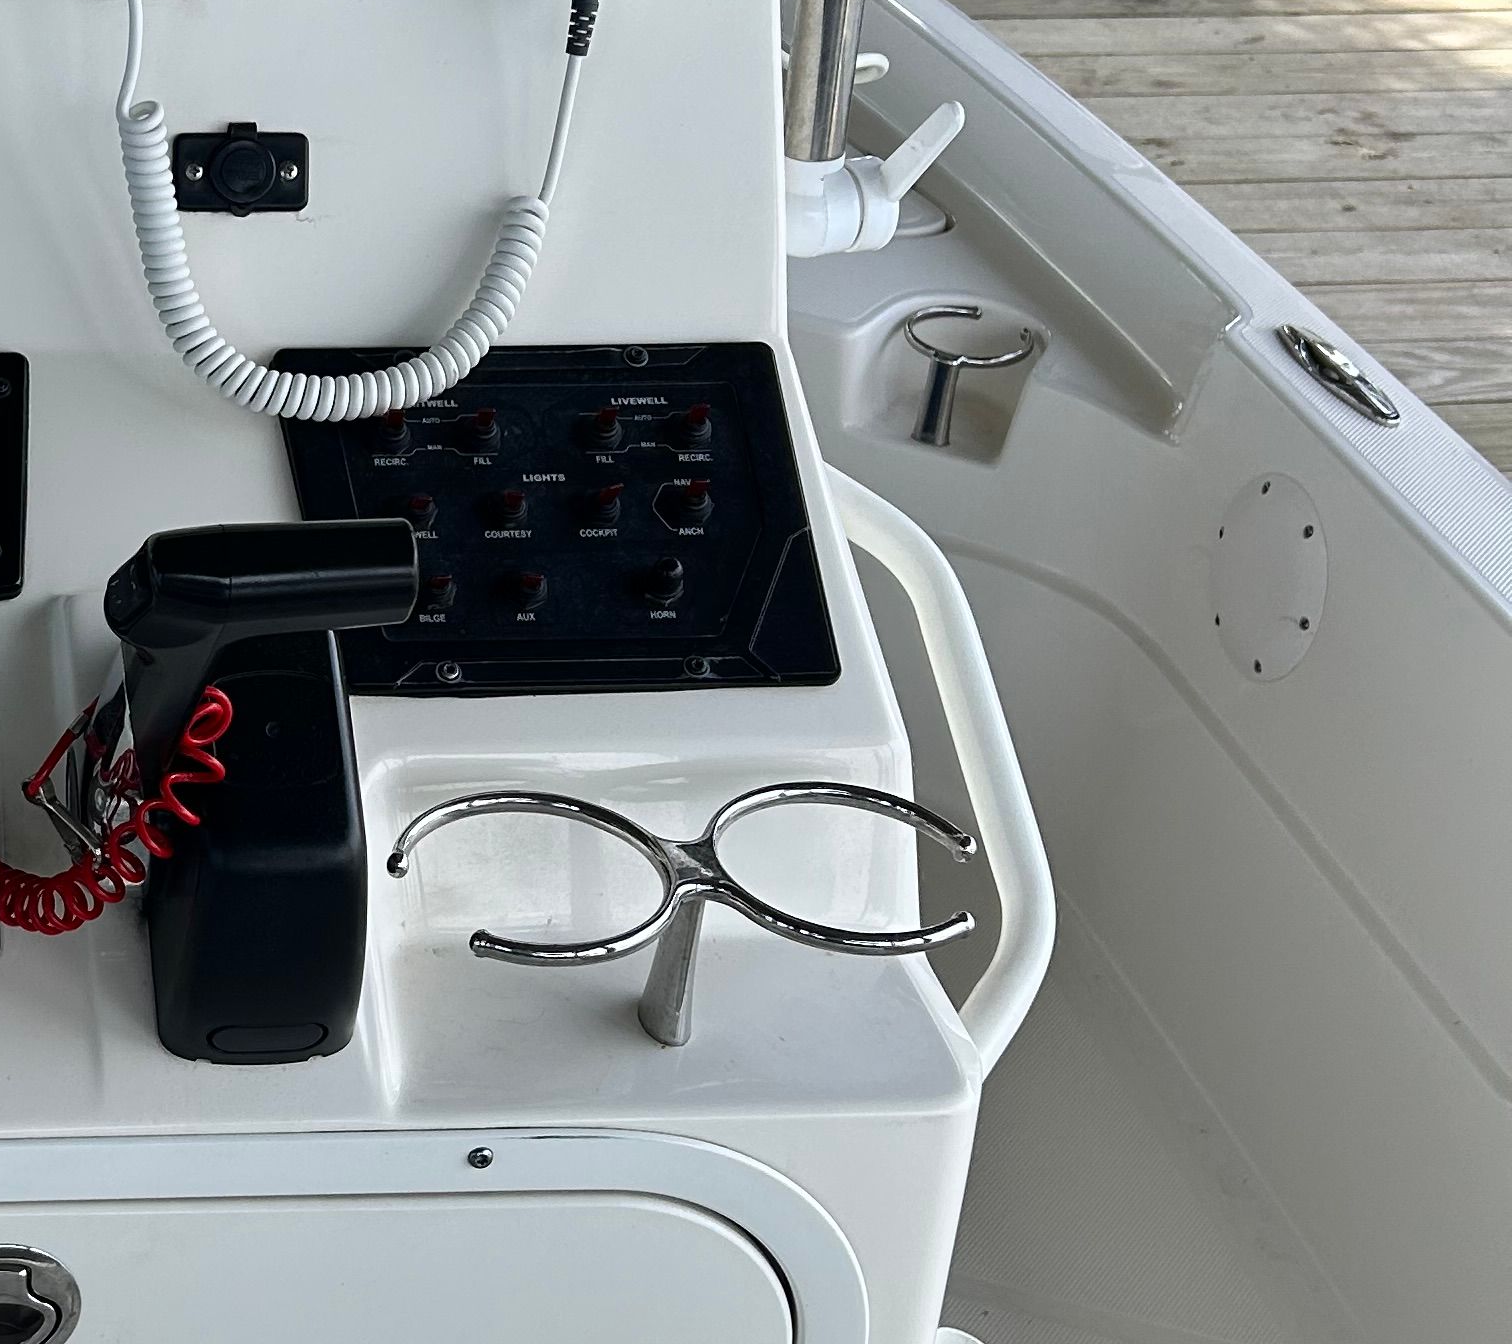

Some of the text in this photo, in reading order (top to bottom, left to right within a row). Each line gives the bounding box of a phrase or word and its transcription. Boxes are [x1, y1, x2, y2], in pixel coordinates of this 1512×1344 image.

[610, 397, 668, 405] LIVEWELL
[473, 457, 493, 465] FILL
[595, 455, 615, 464] FILL
[522, 473, 566, 482] LIGHTS
[484, 530, 533, 539] COURTESY
[579, 528, 618, 537] COCKPIT
[678, 527, 705, 536] ANCH
[419, 613, 447, 623] BILGE
[516, 613, 536, 622] AUX
[649, 610, 677, 620] HORN
